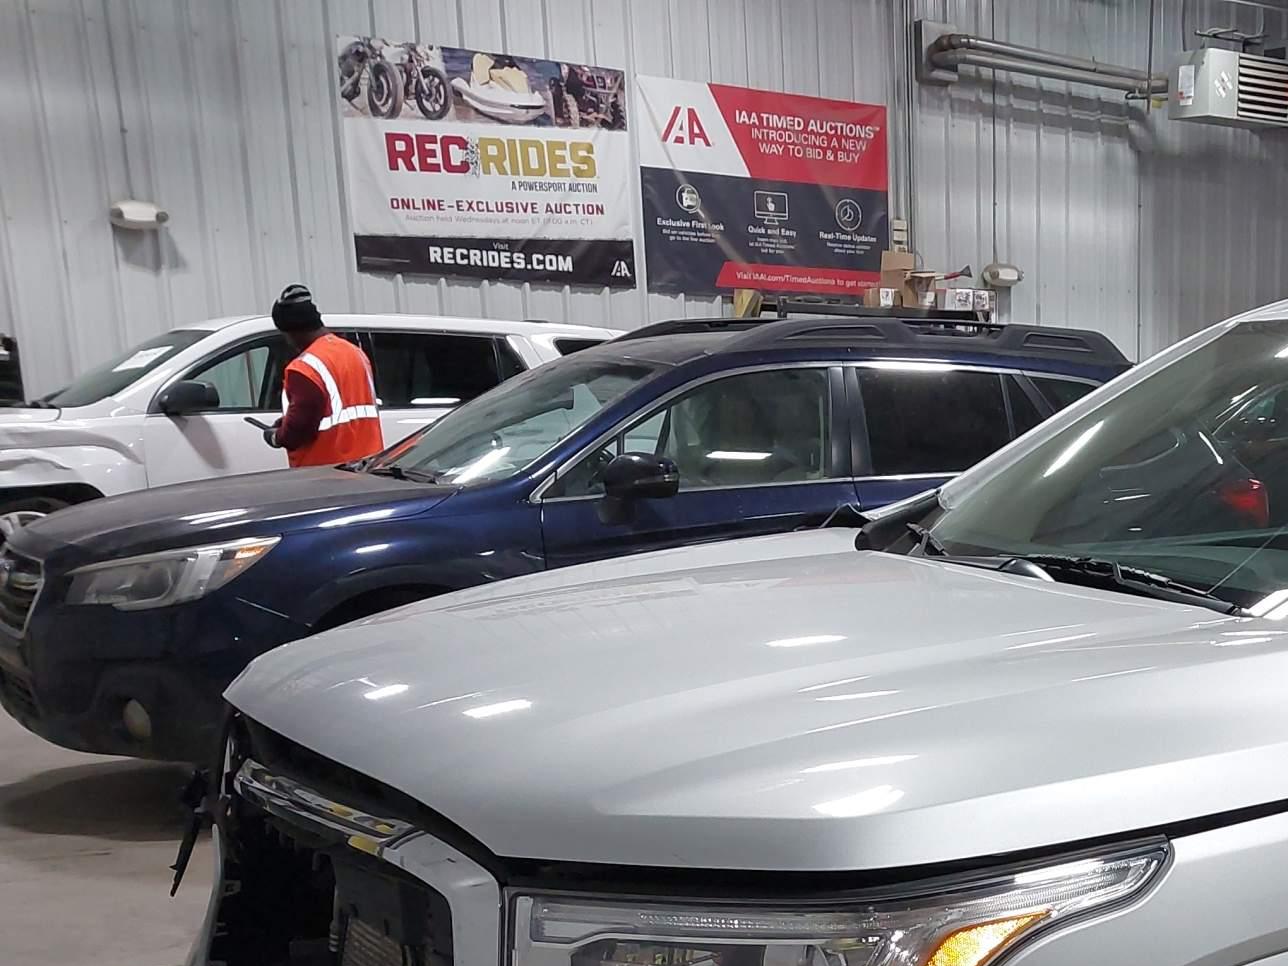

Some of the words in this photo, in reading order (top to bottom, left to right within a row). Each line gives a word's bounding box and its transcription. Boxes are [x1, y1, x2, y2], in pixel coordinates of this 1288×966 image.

[735, 109, 759, 125] IAA
[761, 113, 804, 131] TIMED
[751, 127, 827, 148] INTRODUCING
[830, 136, 839, 149] A
[841, 138, 867, 152] NEW
[385, 132, 471, 175] REC
[478, 136, 599, 179] RIDES
[758, 142, 785, 156] WAY
[787, 145, 803, 158] TO
[806, 147, 824, 160] BID
[826, 149, 834, 161] &
[837, 150, 861, 164] BUY
[512, 181, 518, 191] A
[518, 181, 567, 193] POWERSPORT
[568, 182, 598, 193] AUCTION
[390, 197, 539, 215] ONLINE-EXCLUSIVE
[545, 202, 605, 216] AUCTION
[405, 214, 434, 222] Auction
[436, 214, 452, 223] held
[455, 215, 500, 226] Wednesdays
[656, 217, 690, 228] Exclusive
[747, 224, 766, 235] Quick
[781, 227, 797, 239] Easy
[819, 231, 852, 242] Real-Time
[852, 232, 878, 243] Updates
[492, 242, 509, 250] Visit
[429, 246, 573, 273] RECRIDES.COM
[736, 271, 751, 280] Visit
[837, 277, 844, 285] to
[845, 278, 856, 288] get
